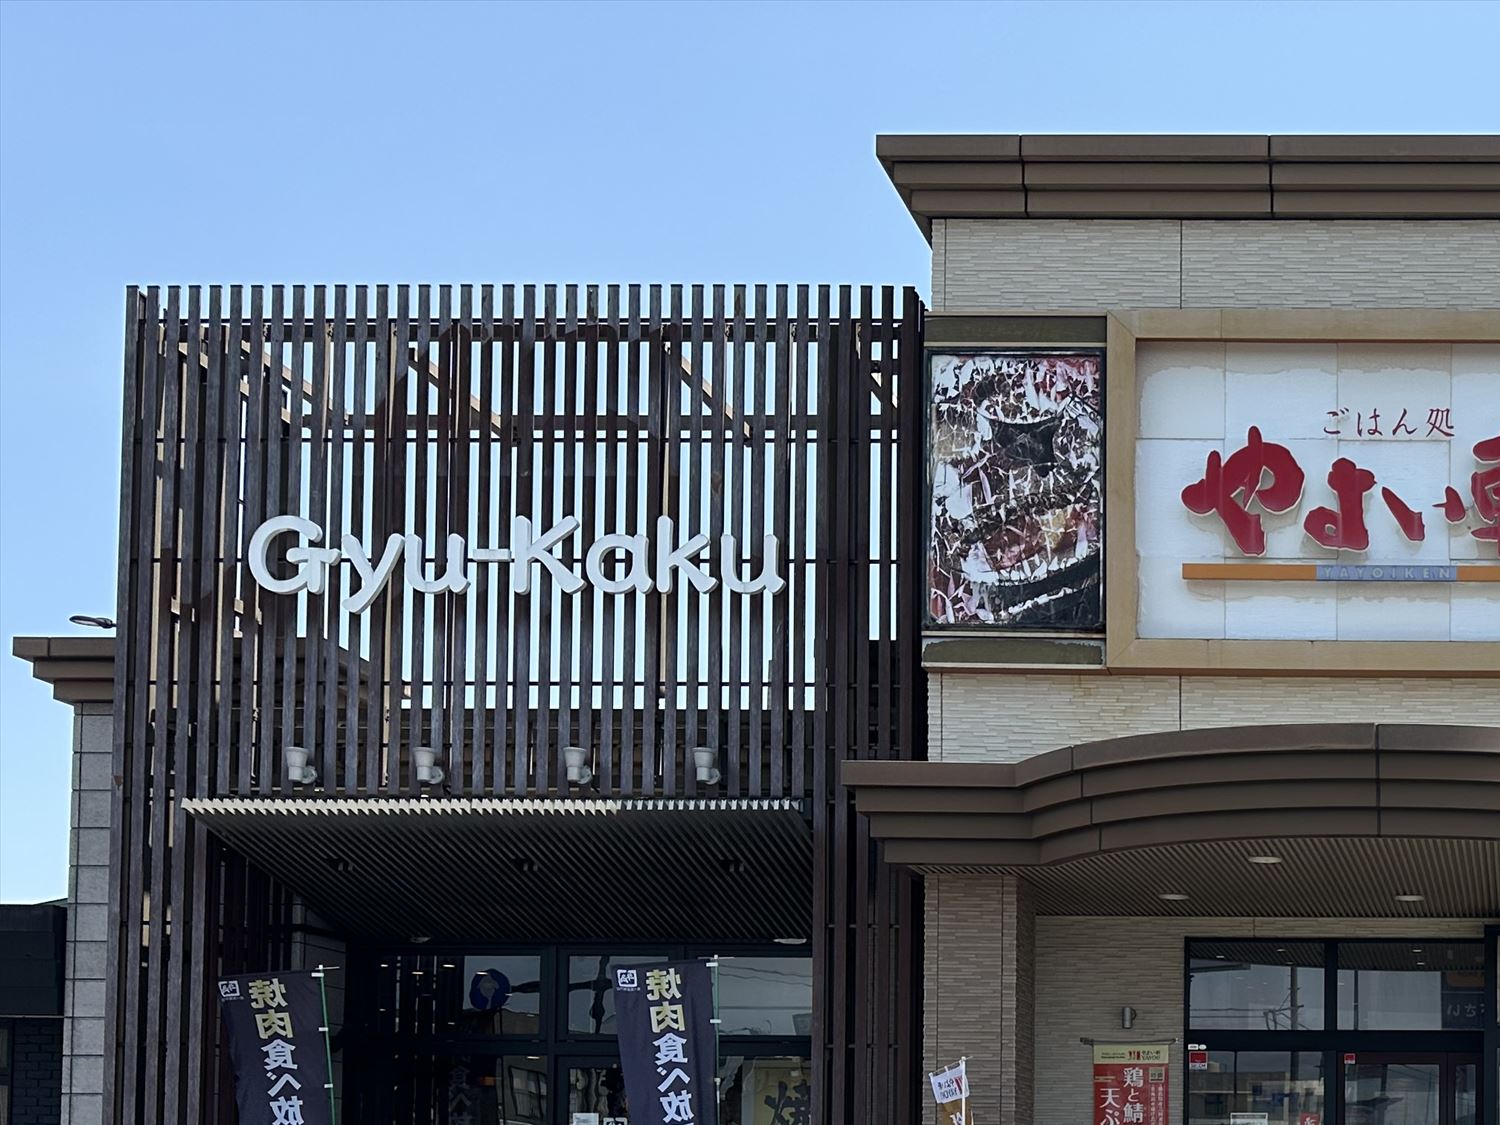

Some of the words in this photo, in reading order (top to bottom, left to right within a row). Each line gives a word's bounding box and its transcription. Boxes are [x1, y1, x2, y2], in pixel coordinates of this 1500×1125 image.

[1322, 407, 1456, 438] ごはん処
[248, 514, 788, 615] Gyu-Kaku
[1322, 567, 1451, 579] YAYOIKEN
